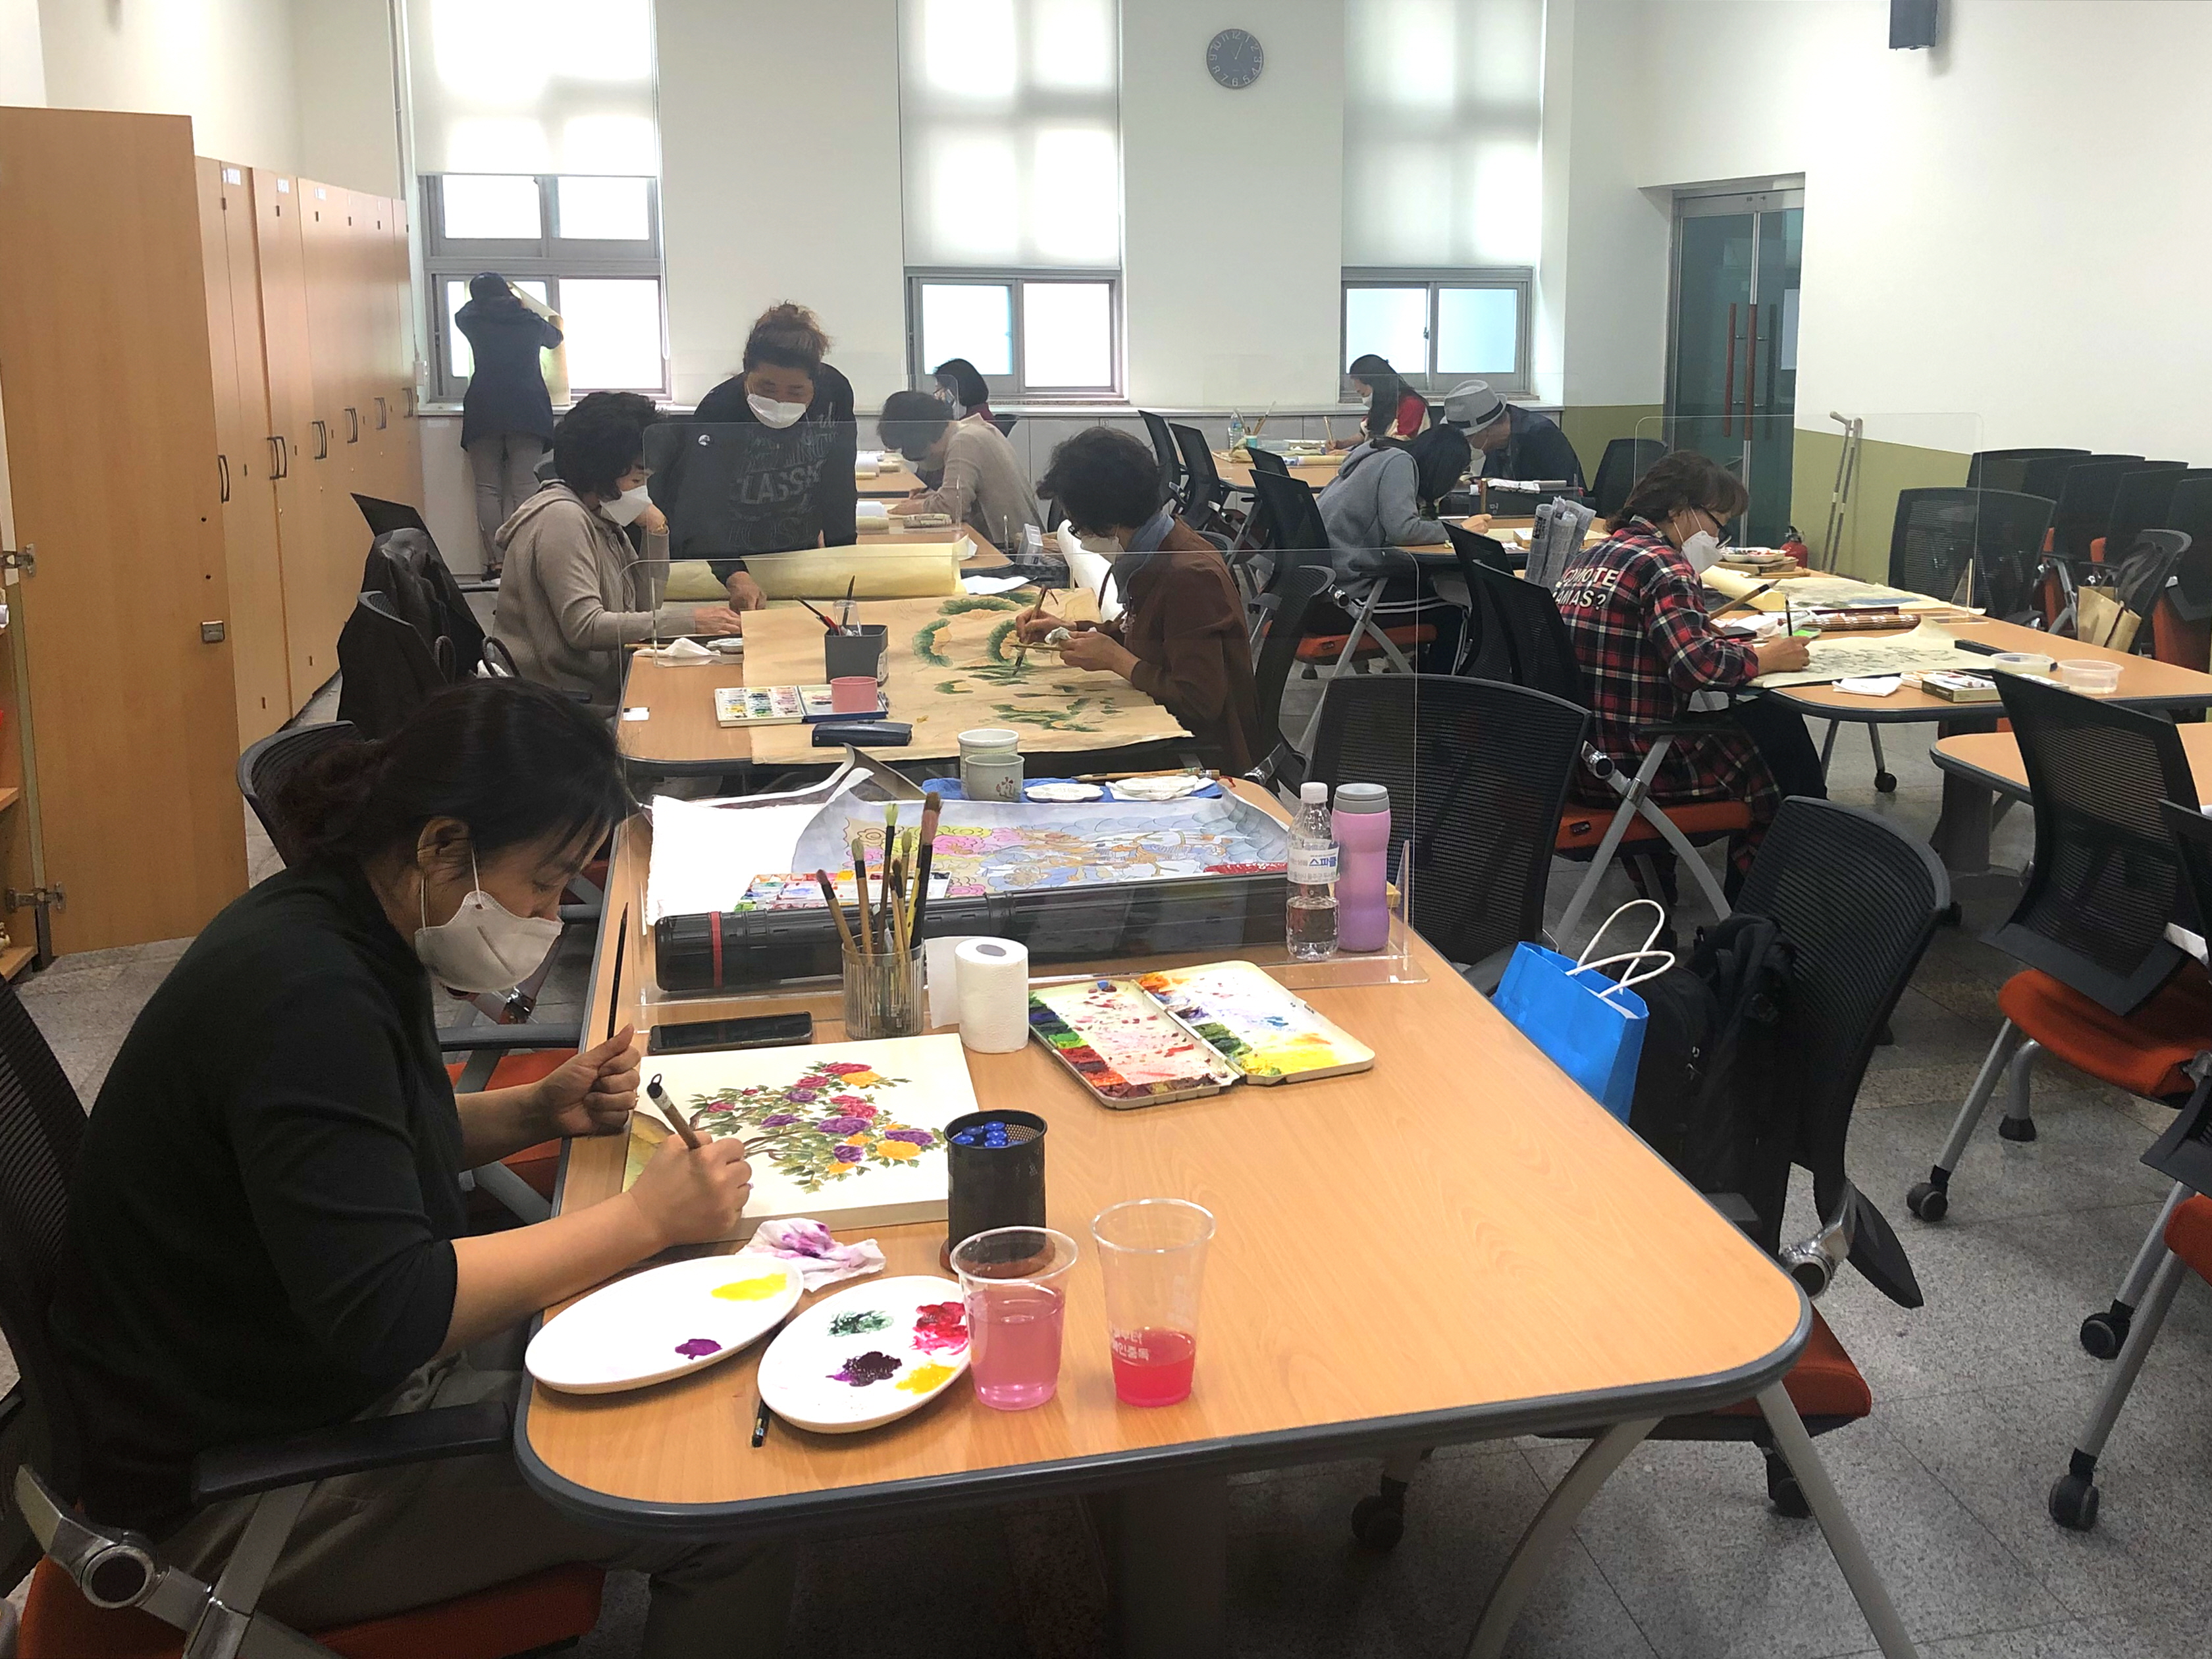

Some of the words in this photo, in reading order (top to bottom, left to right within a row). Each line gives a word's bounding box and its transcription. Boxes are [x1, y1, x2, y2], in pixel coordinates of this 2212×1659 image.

[1221, 33, 1229, 42] 11
[1232, 31, 1241, 40] 12
[1212, 41, 1222, 51] 10
[1250, 43, 1259, 52] 2
[1221, 73, 1229, 82] 7
[1232, 77, 1238, 86] 6
[1552, 590, 1607, 610] AMAS?
